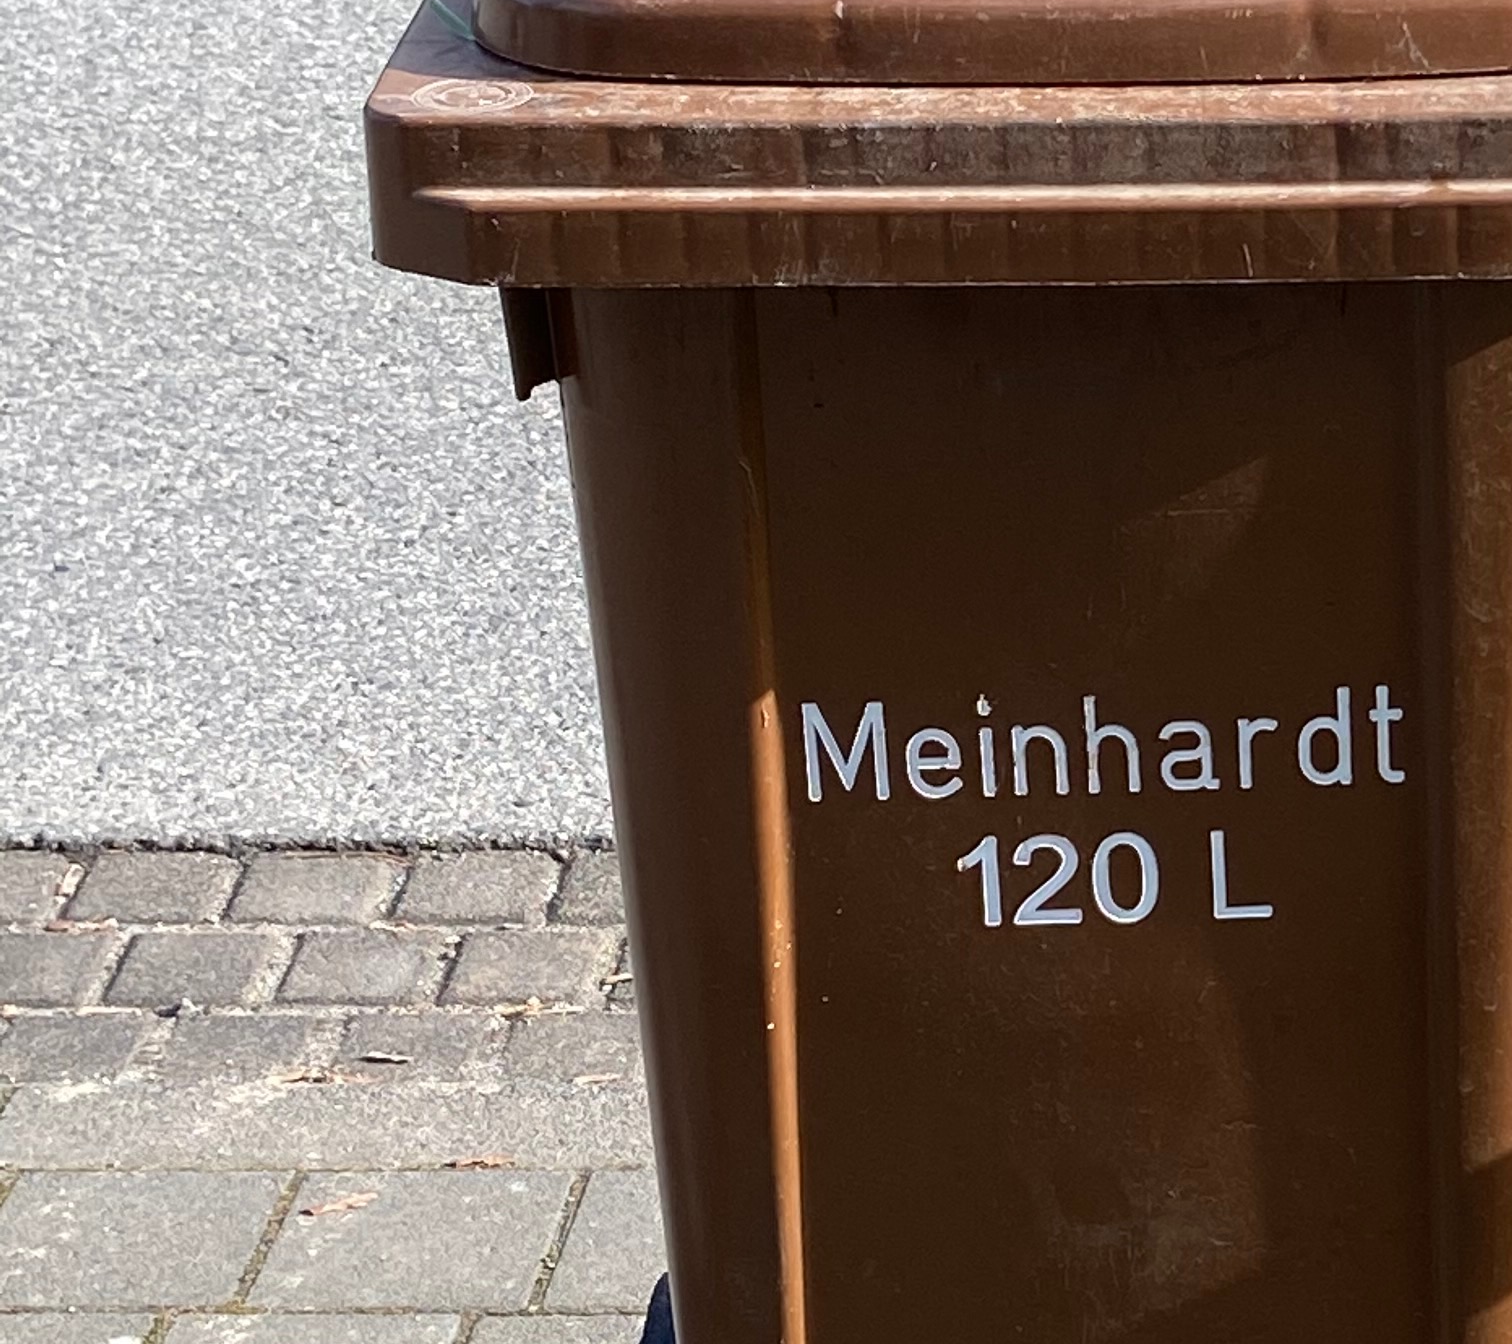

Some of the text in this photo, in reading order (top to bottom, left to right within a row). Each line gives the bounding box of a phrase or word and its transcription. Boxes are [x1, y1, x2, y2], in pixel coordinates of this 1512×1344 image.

[799, 685, 1407, 803] Meinhardt
[956, 830, 1274, 927] 120 L
